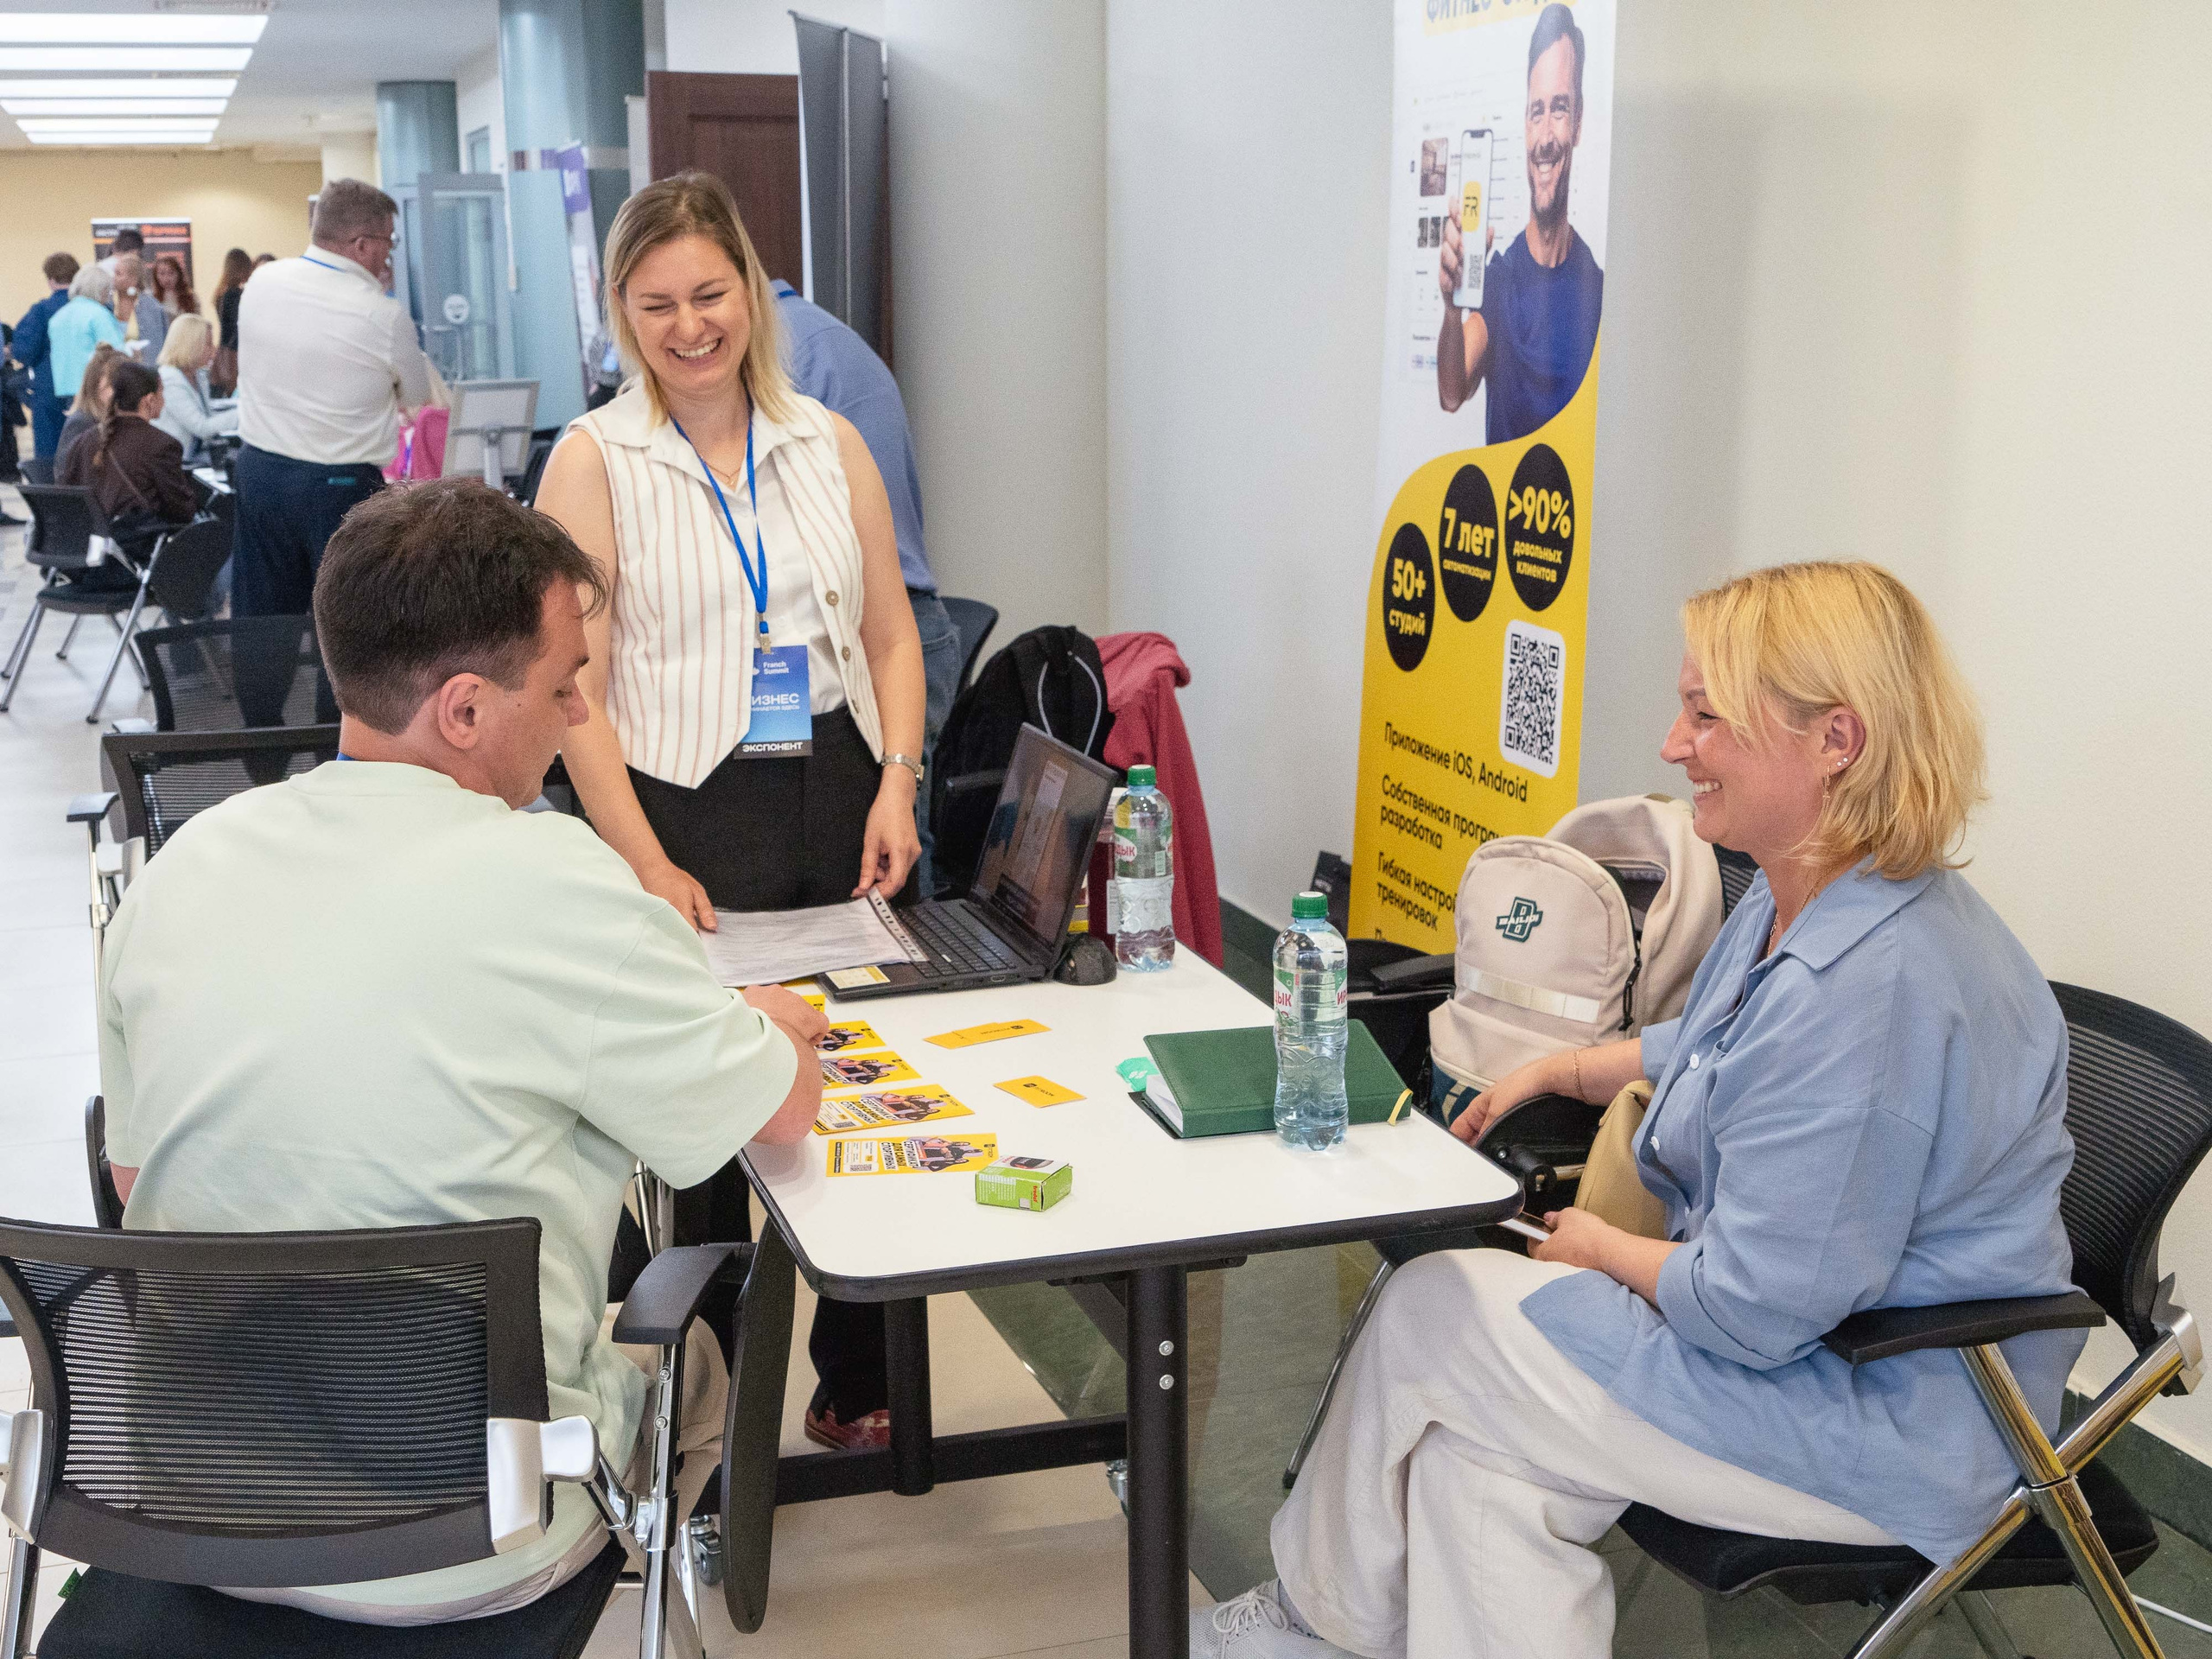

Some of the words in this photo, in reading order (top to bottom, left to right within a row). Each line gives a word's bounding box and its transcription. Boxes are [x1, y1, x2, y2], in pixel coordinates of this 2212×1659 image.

[1444, 506, 1457, 549] 7
[1458, 521, 1496, 559] лет
[1509, 485, 1572, 539] >90%
[1391, 557, 1427, 601] 50+
[1516, 560, 1558, 583] клиентов
[1389, 607, 1427, 637] студий
[751, 693, 800, 706] ИЗНЕС
[742, 741, 804, 753] ЭКСПОНЕНТ
[1384, 721, 1451, 770] Приложение
[1478, 762, 1529, 803] Android
[1380, 804, 1443, 850] разработка
[1382, 773, 1451, 826] Собственная
[1453, 812, 1500, 847] програ
[1377, 851, 1412, 889] Гибкая
[1377, 880, 1438, 932] тренировок
